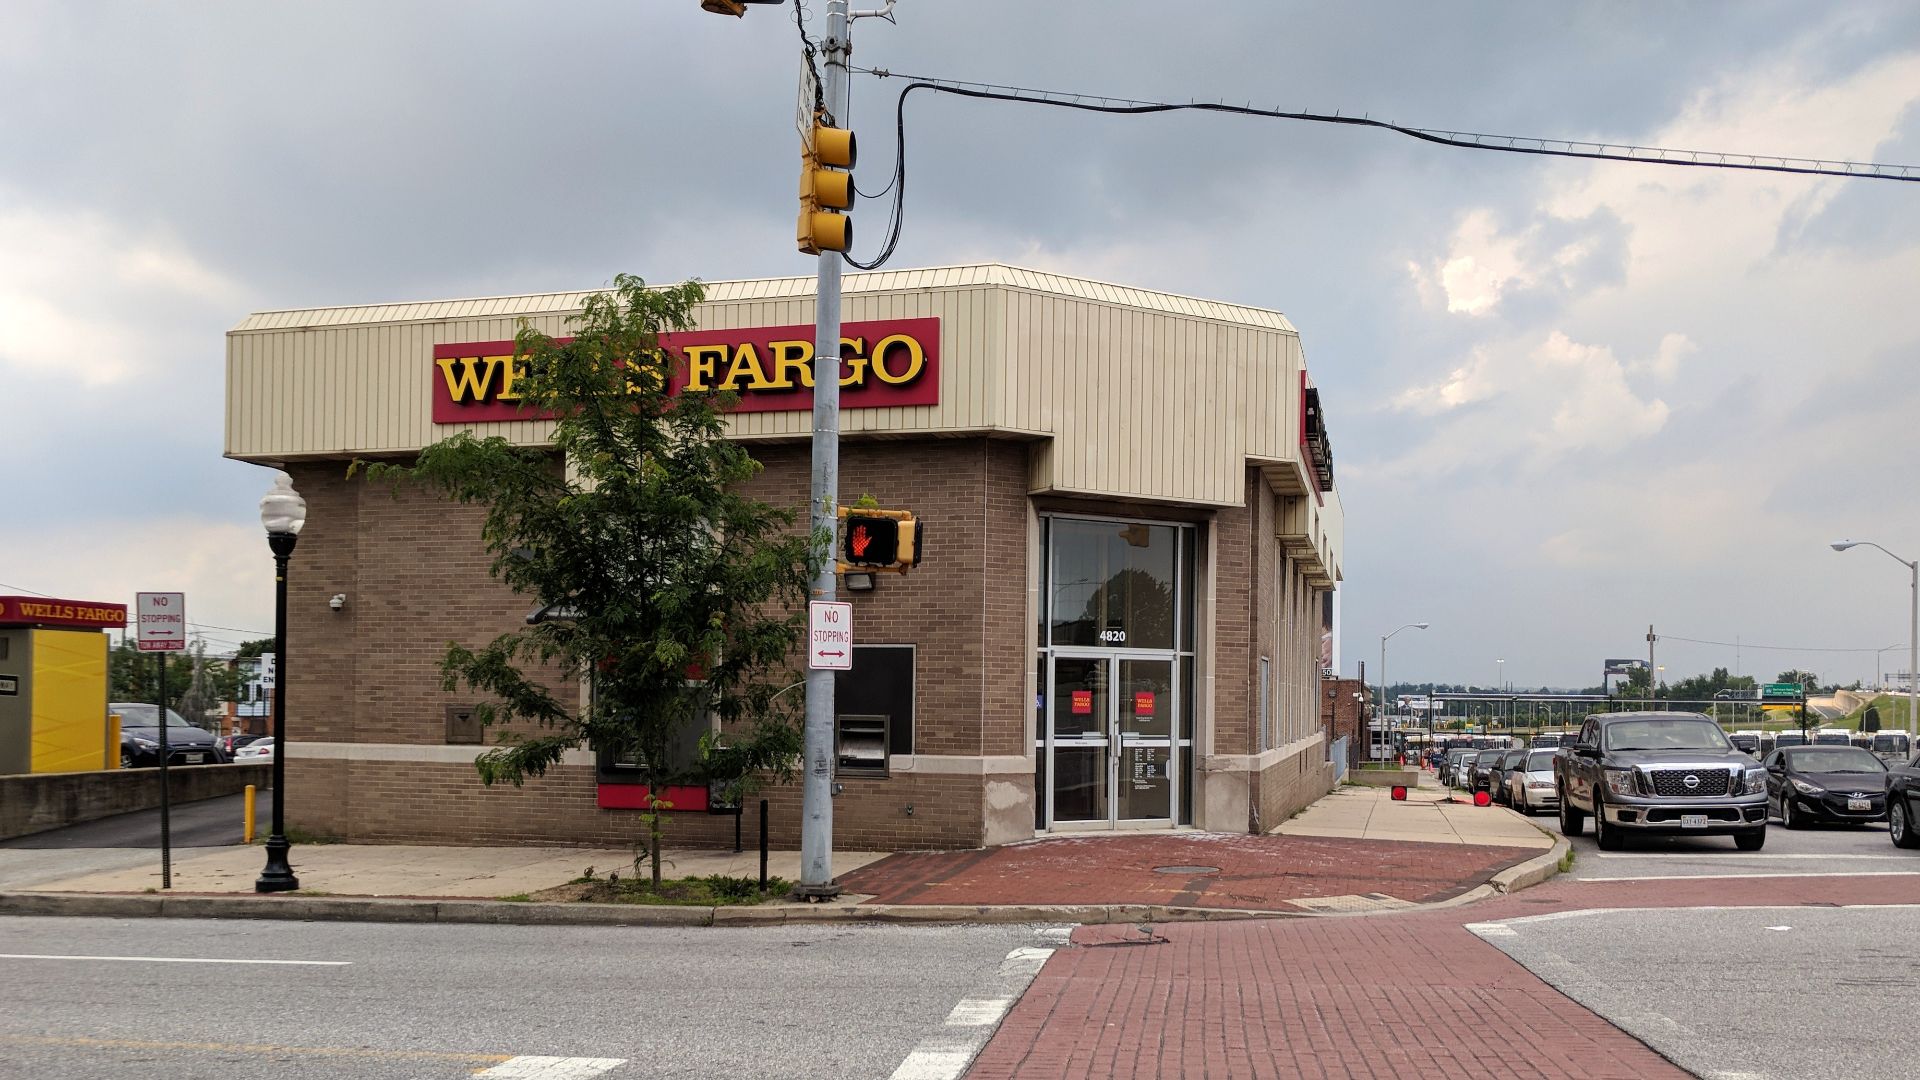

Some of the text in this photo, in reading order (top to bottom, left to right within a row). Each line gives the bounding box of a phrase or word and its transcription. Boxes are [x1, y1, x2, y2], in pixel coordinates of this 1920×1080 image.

[436, 333, 924, 402] WES FARGO
[153, 596, 168, 607] NO
[19, 602, 73, 619] WELLS
[76, 606, 125, 622] FARGO
[141, 614, 181, 623] STOPPING
[824, 610, 838, 623] NO
[814, 630, 849, 643] STOPPING
[1100, 630, 1125, 641] 4820
